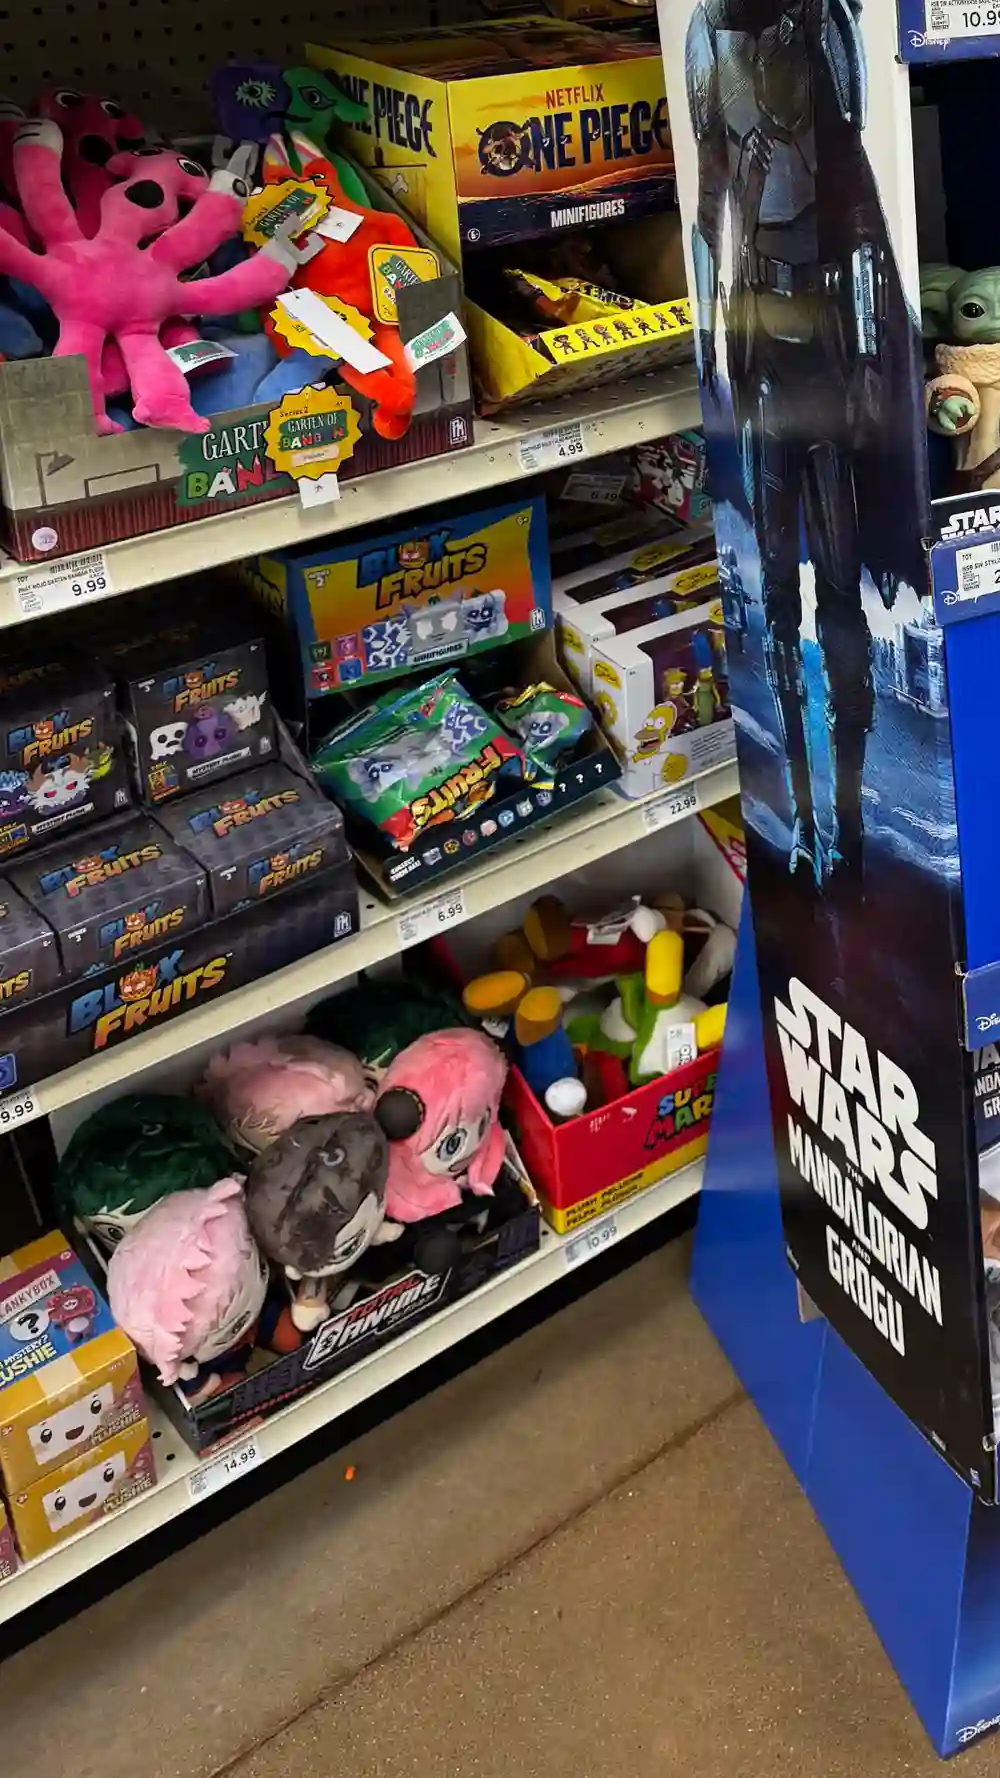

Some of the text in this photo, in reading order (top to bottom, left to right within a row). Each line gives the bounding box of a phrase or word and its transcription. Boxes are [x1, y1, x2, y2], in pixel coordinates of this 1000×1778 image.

[545, 82, 605, 111] NETFLIX
[580, 95, 671, 165] PIECE
[549, 197, 626, 229] MINIFIGURES
[375, 543, 488, 610] FRUITS
[437, 903, 464, 922] 6.99
[774, 977, 936, 1179] STAR
[777, 1025, 938, 1232] WARS
[789, 1113, 943, 1327] MANDALORIAN
[826, 1226, 906, 1357] GROGU
